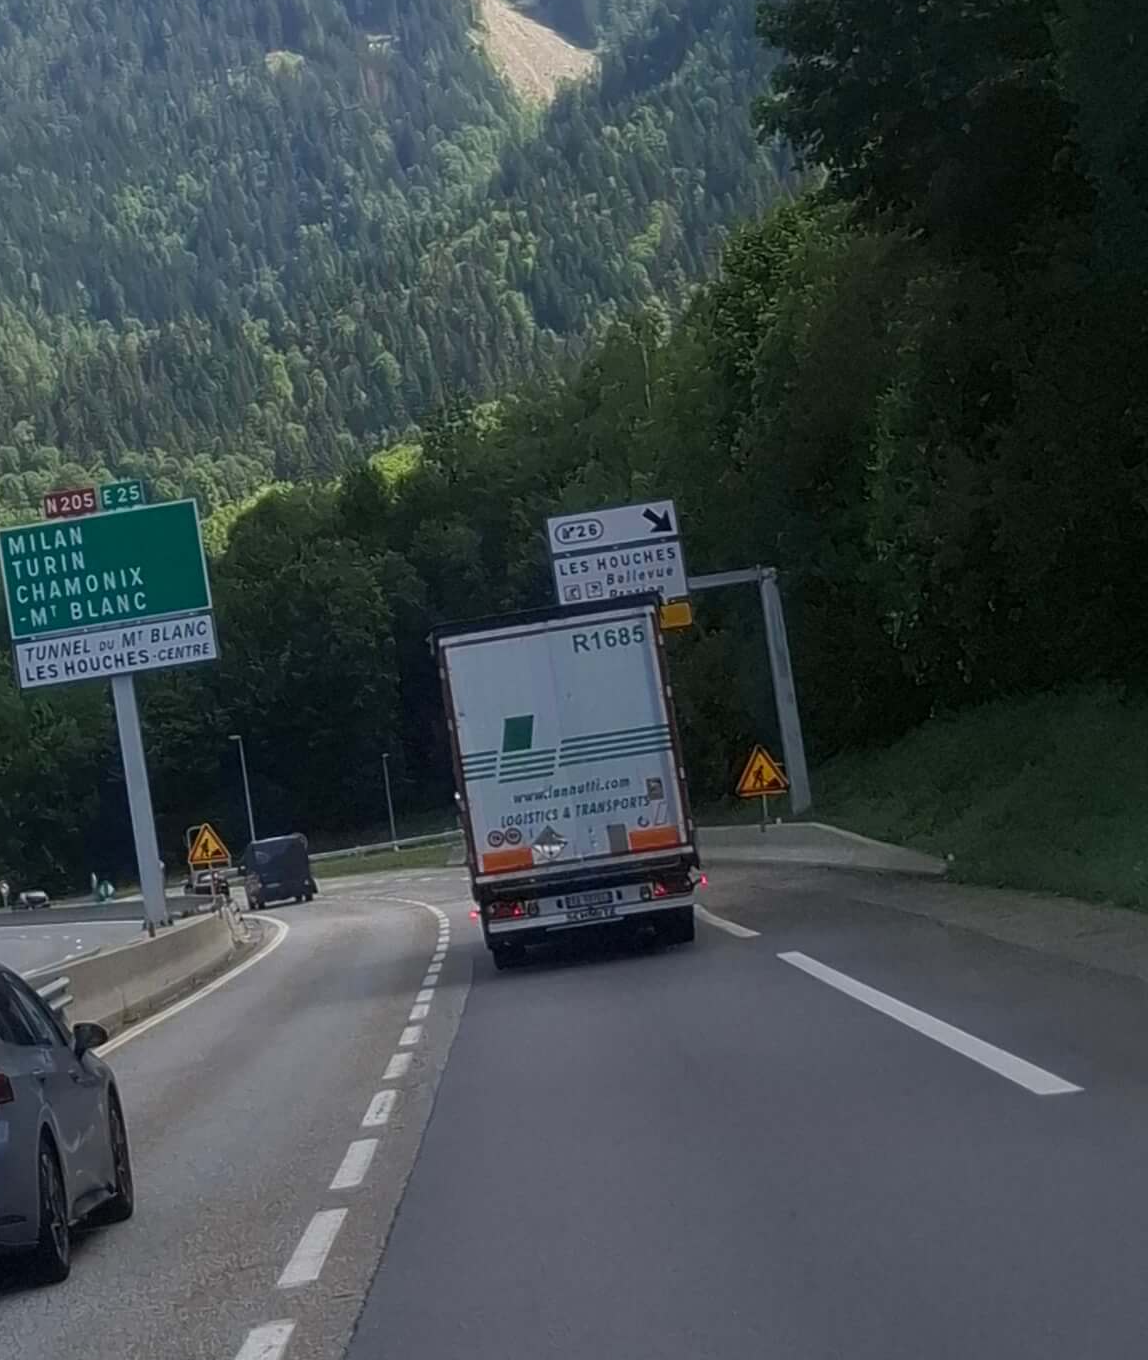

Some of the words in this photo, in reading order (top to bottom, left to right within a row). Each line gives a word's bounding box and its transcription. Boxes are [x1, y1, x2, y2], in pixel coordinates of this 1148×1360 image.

[7, 526, 84, 556] MILAN
[12, 551, 86, 580] TURIN
[559, 561, 589, 576] LES
[597, 547, 676, 571] HOUCHES
[16, 567, 144, 604] CHAMONIX
[606, 567, 673, 586] Bellevue
[70, 592, 147, 621] BLANC
[25, 640, 92, 663] TUNNEL
[151, 621, 208, 644] BLANC
[572, 625, 645, 654] R1685
[25, 663, 58, 683] LES
[65, 649, 149, 677] HOUCHES
[500, 808, 558, 828] LOGISTICS
[563, 806, 571, 819] &
[576, 795, 650, 818] TRANSPORTS
